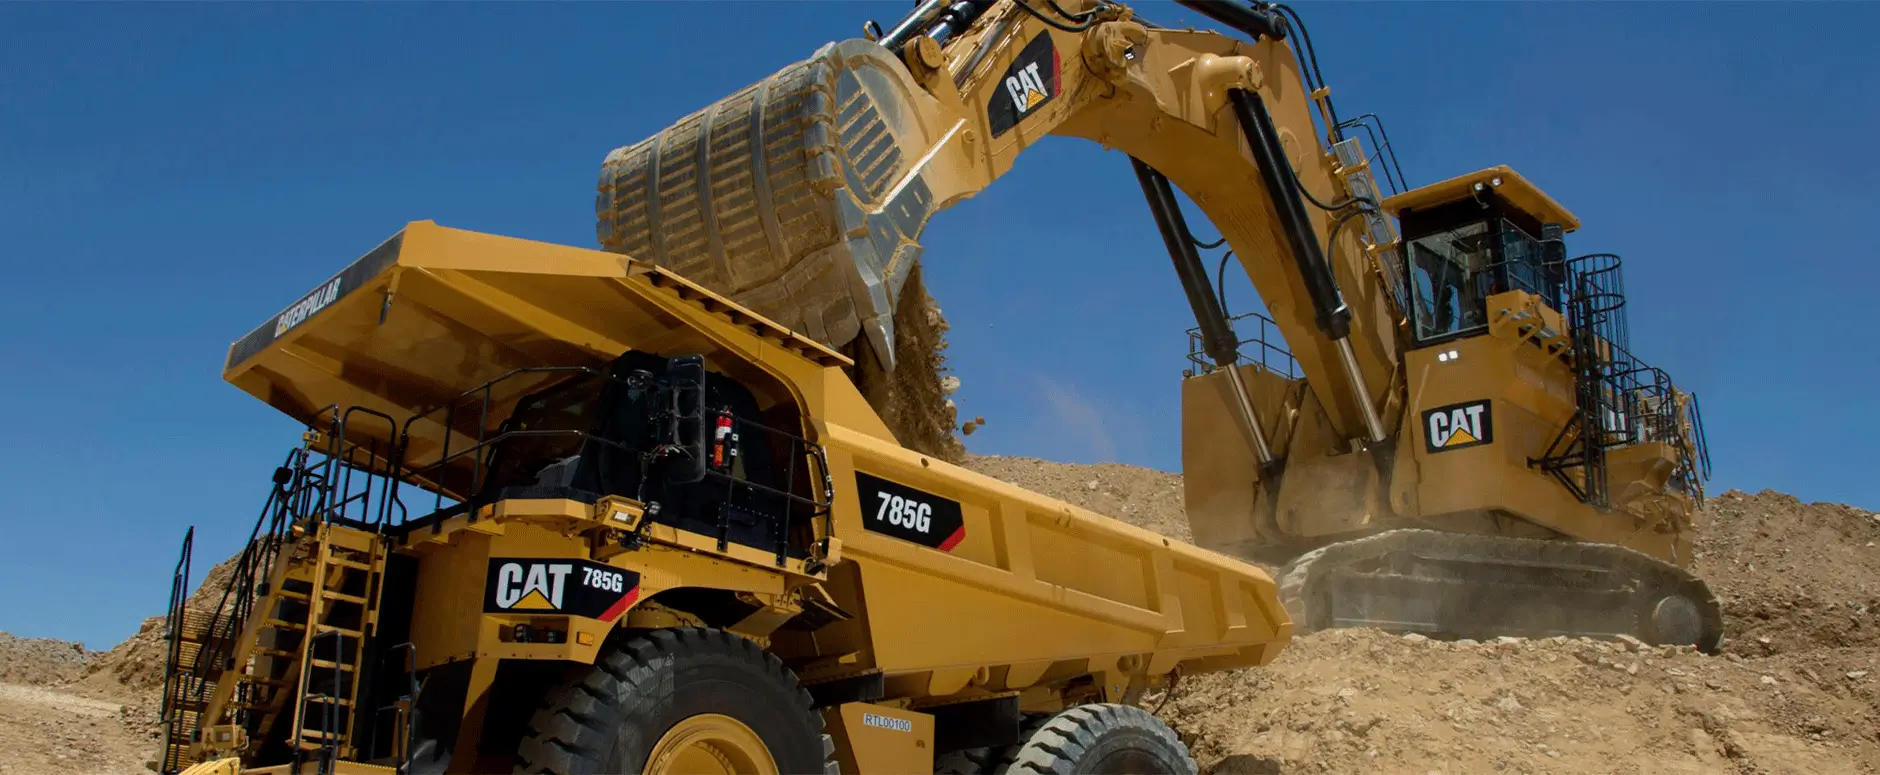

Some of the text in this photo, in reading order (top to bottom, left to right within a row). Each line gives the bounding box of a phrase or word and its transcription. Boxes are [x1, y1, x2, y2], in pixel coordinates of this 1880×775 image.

[1006, 61, 1048, 113] CAT
[274, 276, 342, 338] CATERPILLAR
[1429, 404, 1485, 448] CAT
[876, 491, 932, 533] 785G
[496, 562, 623, 610] CAT 785G
[864, 713, 911, 732] RTL00100
